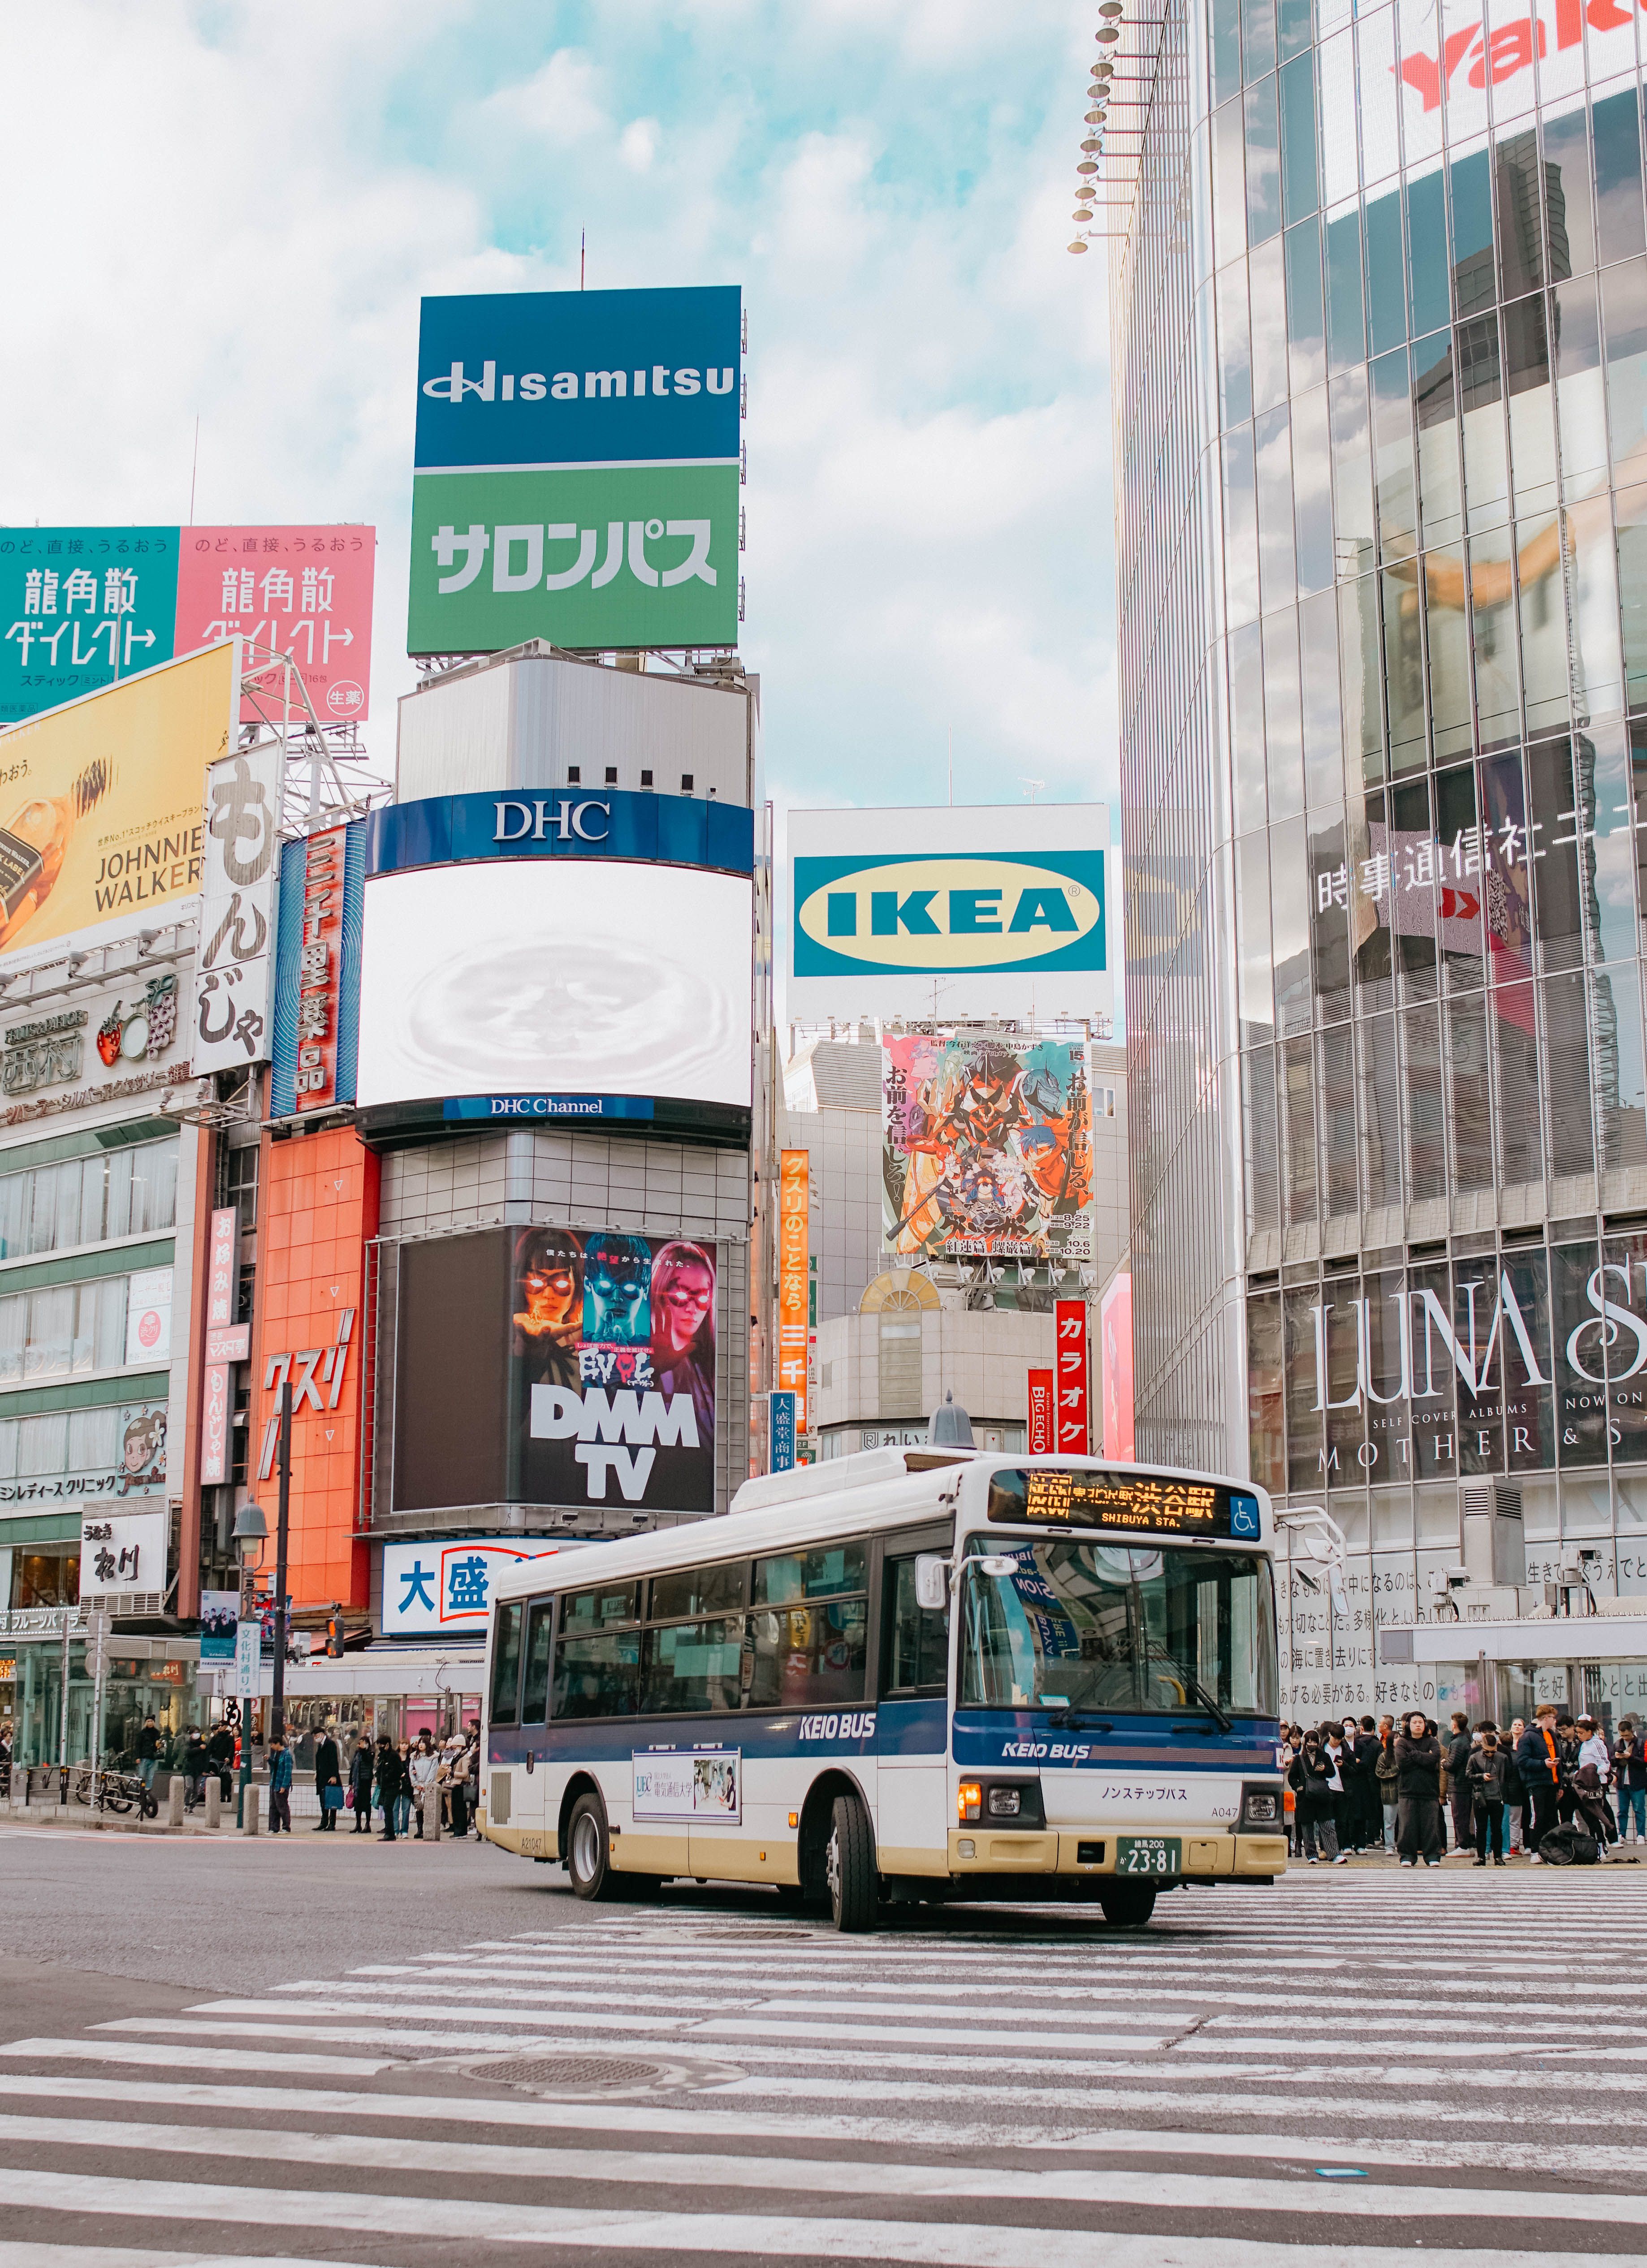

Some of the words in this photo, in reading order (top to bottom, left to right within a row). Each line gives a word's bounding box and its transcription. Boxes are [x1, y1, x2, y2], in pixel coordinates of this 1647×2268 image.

[1389, 0, 1647, 112] Yak
[423, 360, 734, 403] Hisamitsu
[0, 539, 167, 554] のど、直接、うるおう
[195, 537, 363, 552] のど、直接、うるおう
[432, 518, 717, 594] サロンパス
[25, 568, 139, 614] 龍角散
[221, 567, 335, 613] 龍角散
[5, 621, 157, 666] ダイレクト
[21, 675, 79, 686] スティック
[329, 691, 361, 705] 生薬
[492, 801, 610, 841] DHC
[95, 825, 204, 884] JOHNNIE
[95, 856, 203, 912] WALKER
[199, 758, 273, 1056] もんじゃ
[827, 887, 1080, 937] IKEA
[294, 836, 336, 1094] 三千里薬品
[1069, 1050, 1085, 1061] 15
[491, 1100, 530, 1114] DHC
[533, 1098, 603, 1113] Channel
[784, 1157, 804, 1311] クスリのことなら
[212, 1216, 231, 1320] お好み焼
[1309, 1269, 1553, 1414] LUNA
[1565, 1253, 1647, 1384] S
[264, 1345, 348, 1415] クスリ
[1032, 1387, 1045, 1412] BIG
[1059, 1317, 1085, 1443] カラオケ
[1565, 1395, 1605, 1409] NOW
[1617, 1391, 1642, 1404] ON
[530, 1383, 701, 1448] DMM
[775, 1397, 791, 1473] 大盛堂商事
[1033, 1414, 1046, 1453] ECHO
[1373, 1416, 1403, 1430] SELF
[1412, 1410, 1457, 1425] COVER
[1468, 1403, 1527, 1419] ALBUMS
[1317, 1427, 1536, 1472] MOTHER
[1563, 1427, 1580, 1444] &
[575, 1444, 657, 1501] TV
[1102, 1513, 1149, 1525] SHIBUYA
[1155, 1517, 1181, 1528] STA.
[94, 1544, 140, 1582] 松川
[241, 1629, 252, 1686] 文化村通り
[799, 1714, 836, 1739] KEIO
[838, 1712, 876, 1738] BUS
[1002, 1742, 1048, 1757] KEIO
[1049, 1744, 1090, 1759] BUS
[654, 1781, 692, 1798] 電気通信大学
[1102, 1786, 1188, 1800] ノンステップバス
[1211, 1807, 1238, 1818] A047
[521, 1838, 542, 1850] A21047
[1128, 1849, 1176, 1872] 23-81
